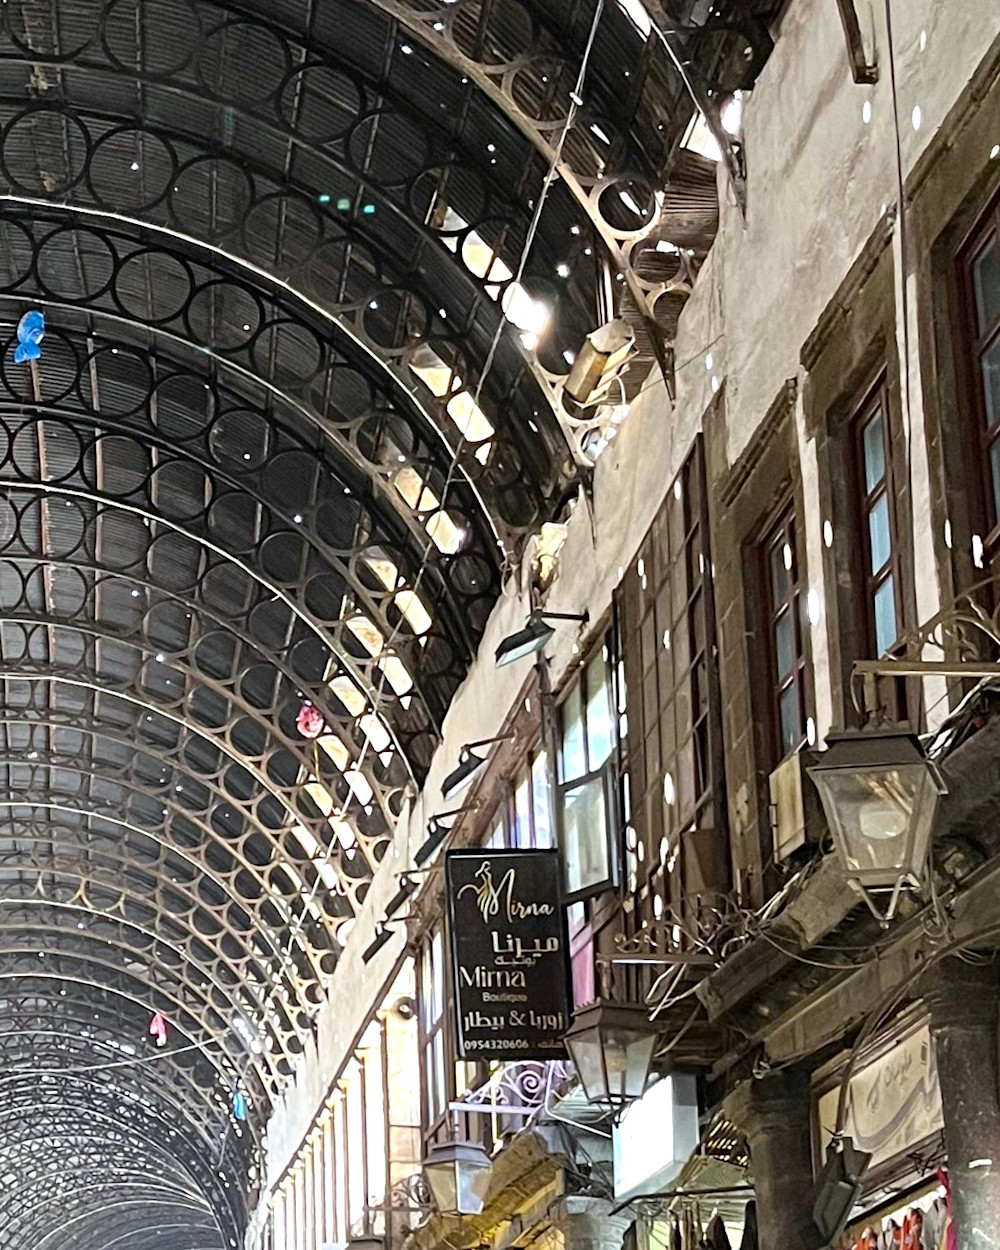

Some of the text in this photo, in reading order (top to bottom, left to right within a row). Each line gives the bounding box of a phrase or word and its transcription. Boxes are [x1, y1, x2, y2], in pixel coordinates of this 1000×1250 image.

[476, 862, 555, 923] Mirna
[491, 931, 559, 958] ميرنا
[460, 966, 526, 988] Mirna
[464, 1011, 505, 1032] بيطار
[509, 1010, 527, 1026] &
[464, 1040, 529, 1050] 0954320606
